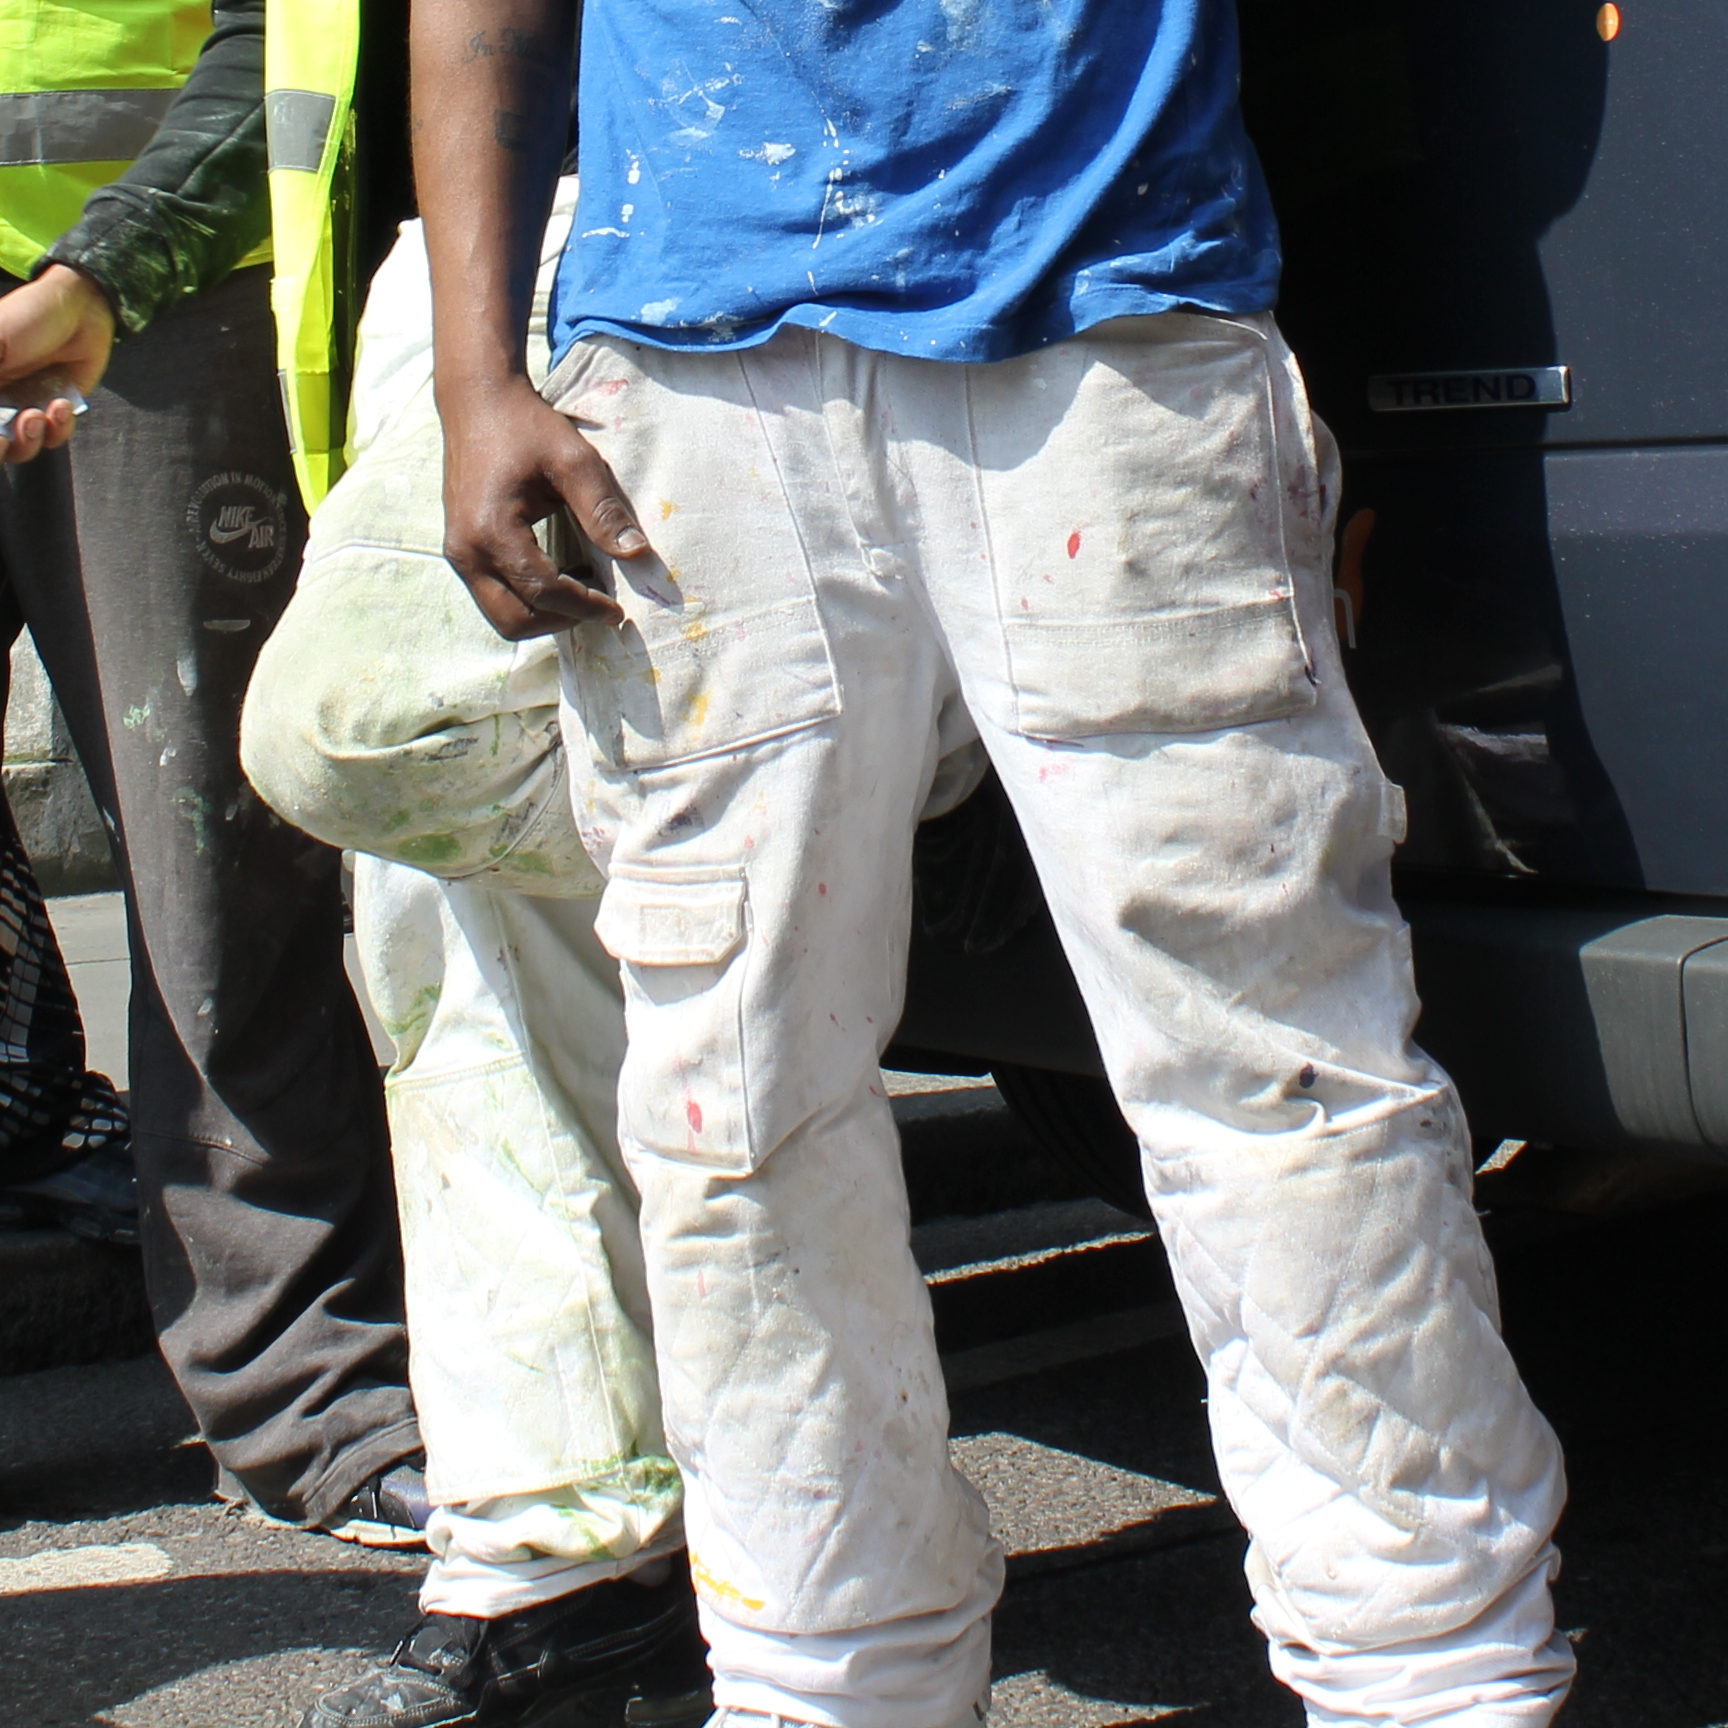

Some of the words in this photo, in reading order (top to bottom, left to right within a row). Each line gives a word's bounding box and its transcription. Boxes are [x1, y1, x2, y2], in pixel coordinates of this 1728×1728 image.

[1387, 373, 1537, 406] TREND
[218, 506, 255, 528] NIKE
[247, 525, 275, 549] AIR
